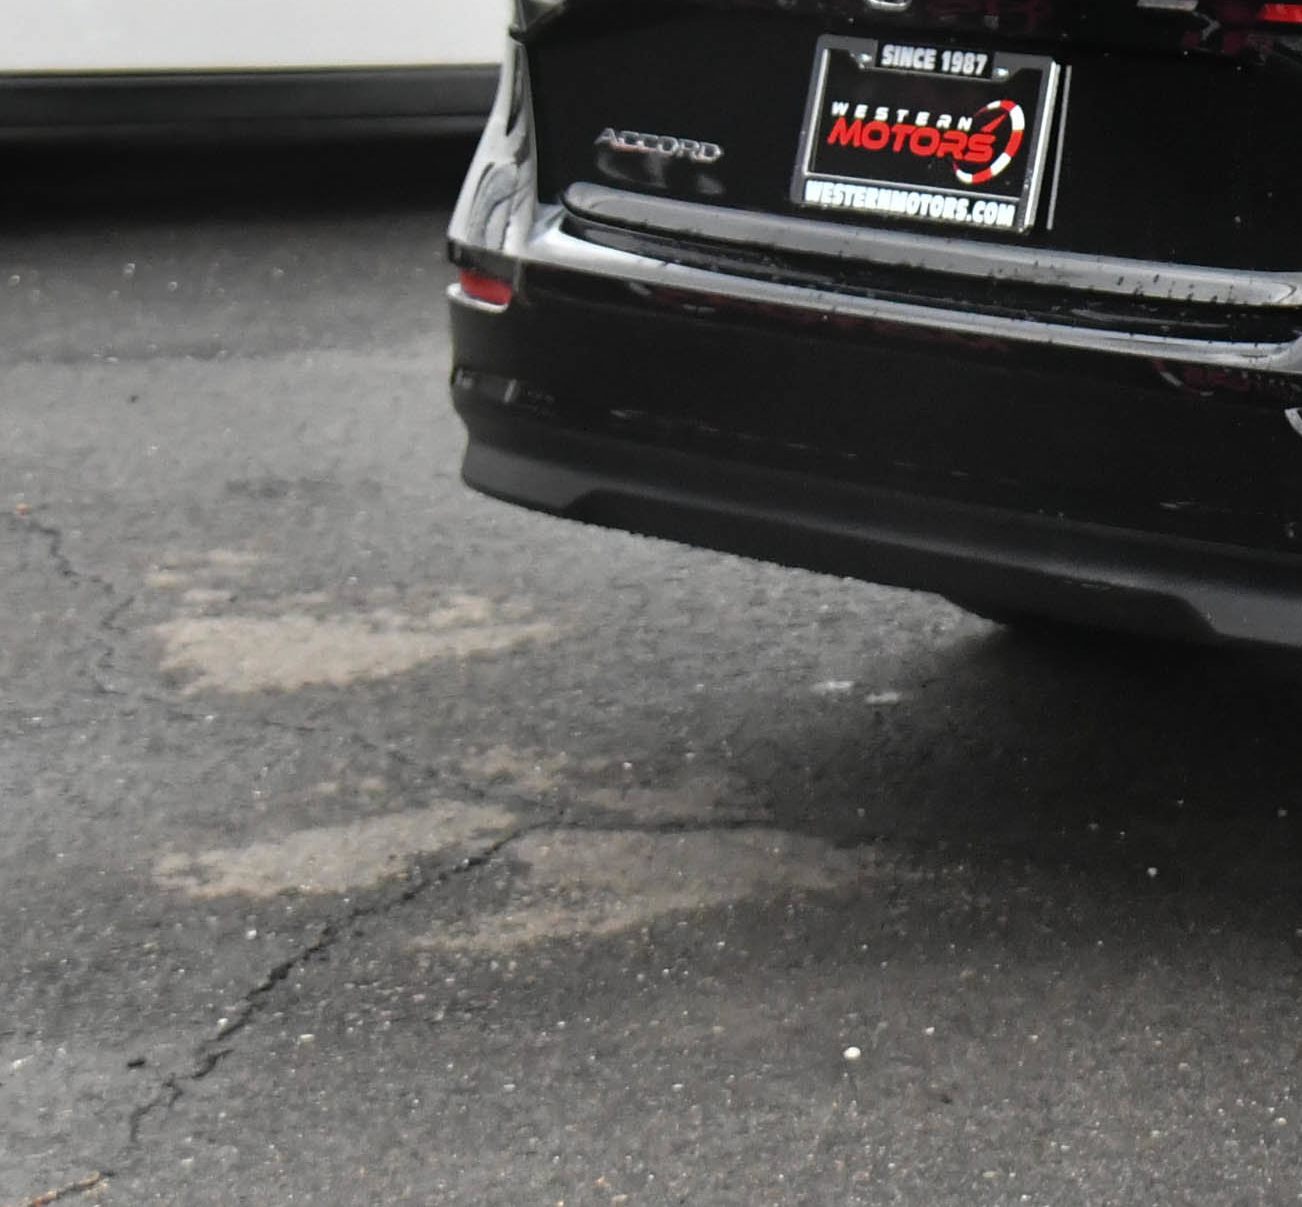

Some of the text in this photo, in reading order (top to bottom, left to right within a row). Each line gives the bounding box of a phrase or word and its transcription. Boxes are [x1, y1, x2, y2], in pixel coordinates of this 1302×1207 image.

[881, 44, 988, 75] SINCE 1987
[831, 101, 973, 131] WESTERN
[594, 127, 724, 163] ACCORD
[827, 117, 996, 163] MOTORS
[804, 180, 1016, 227] WESTERNMOTORS.COM
